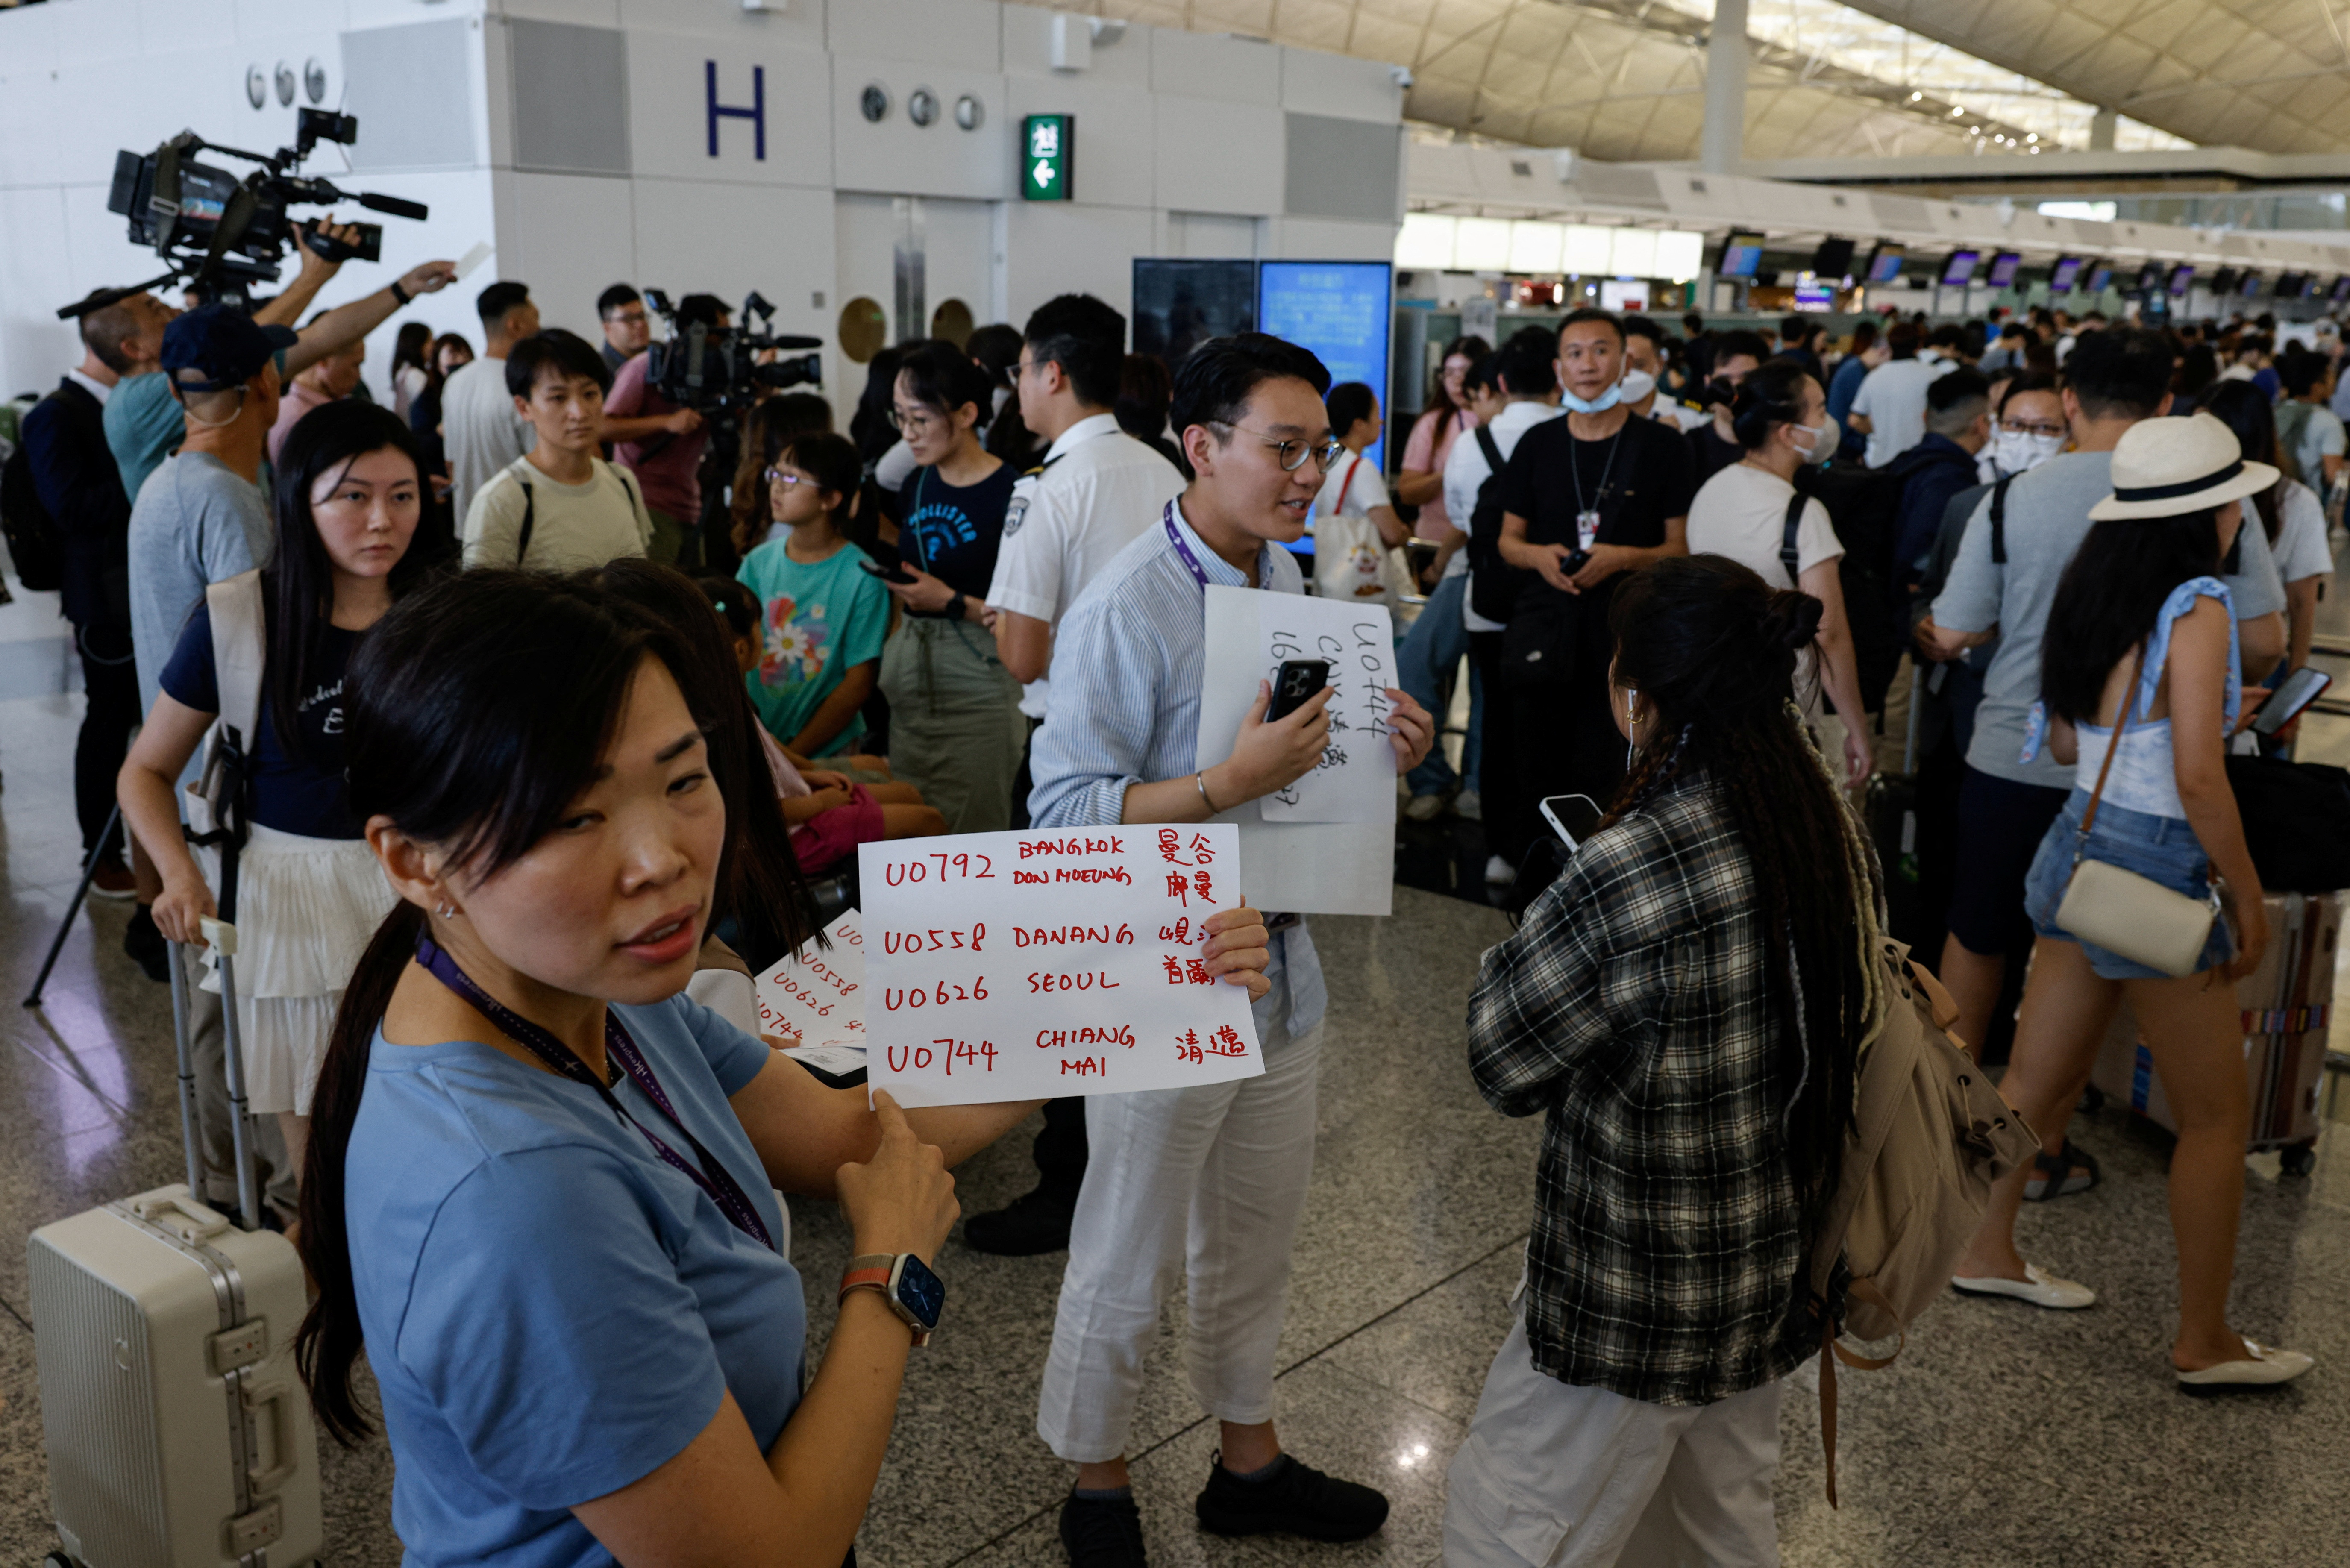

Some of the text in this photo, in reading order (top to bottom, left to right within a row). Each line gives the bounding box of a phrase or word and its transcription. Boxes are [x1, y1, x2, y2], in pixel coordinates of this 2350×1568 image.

[707, 59, 765, 160] H
[1018, 828, 1216, 866] BANGKOK 曼谷
[1013, 870, 1049, 884] DON
[1056, 866, 1132, 886] MOEUNG
[1013, 923, 1134, 948] DANANG
[1159, 916, 1214, 946] 峴
[1028, 972, 1120, 993] SEOUL
[1036, 1025, 1135, 1049] CHIANG
[1175, 1025, 1248, 1064] 清邁
[1061, 1057, 1105, 1077] MAI
